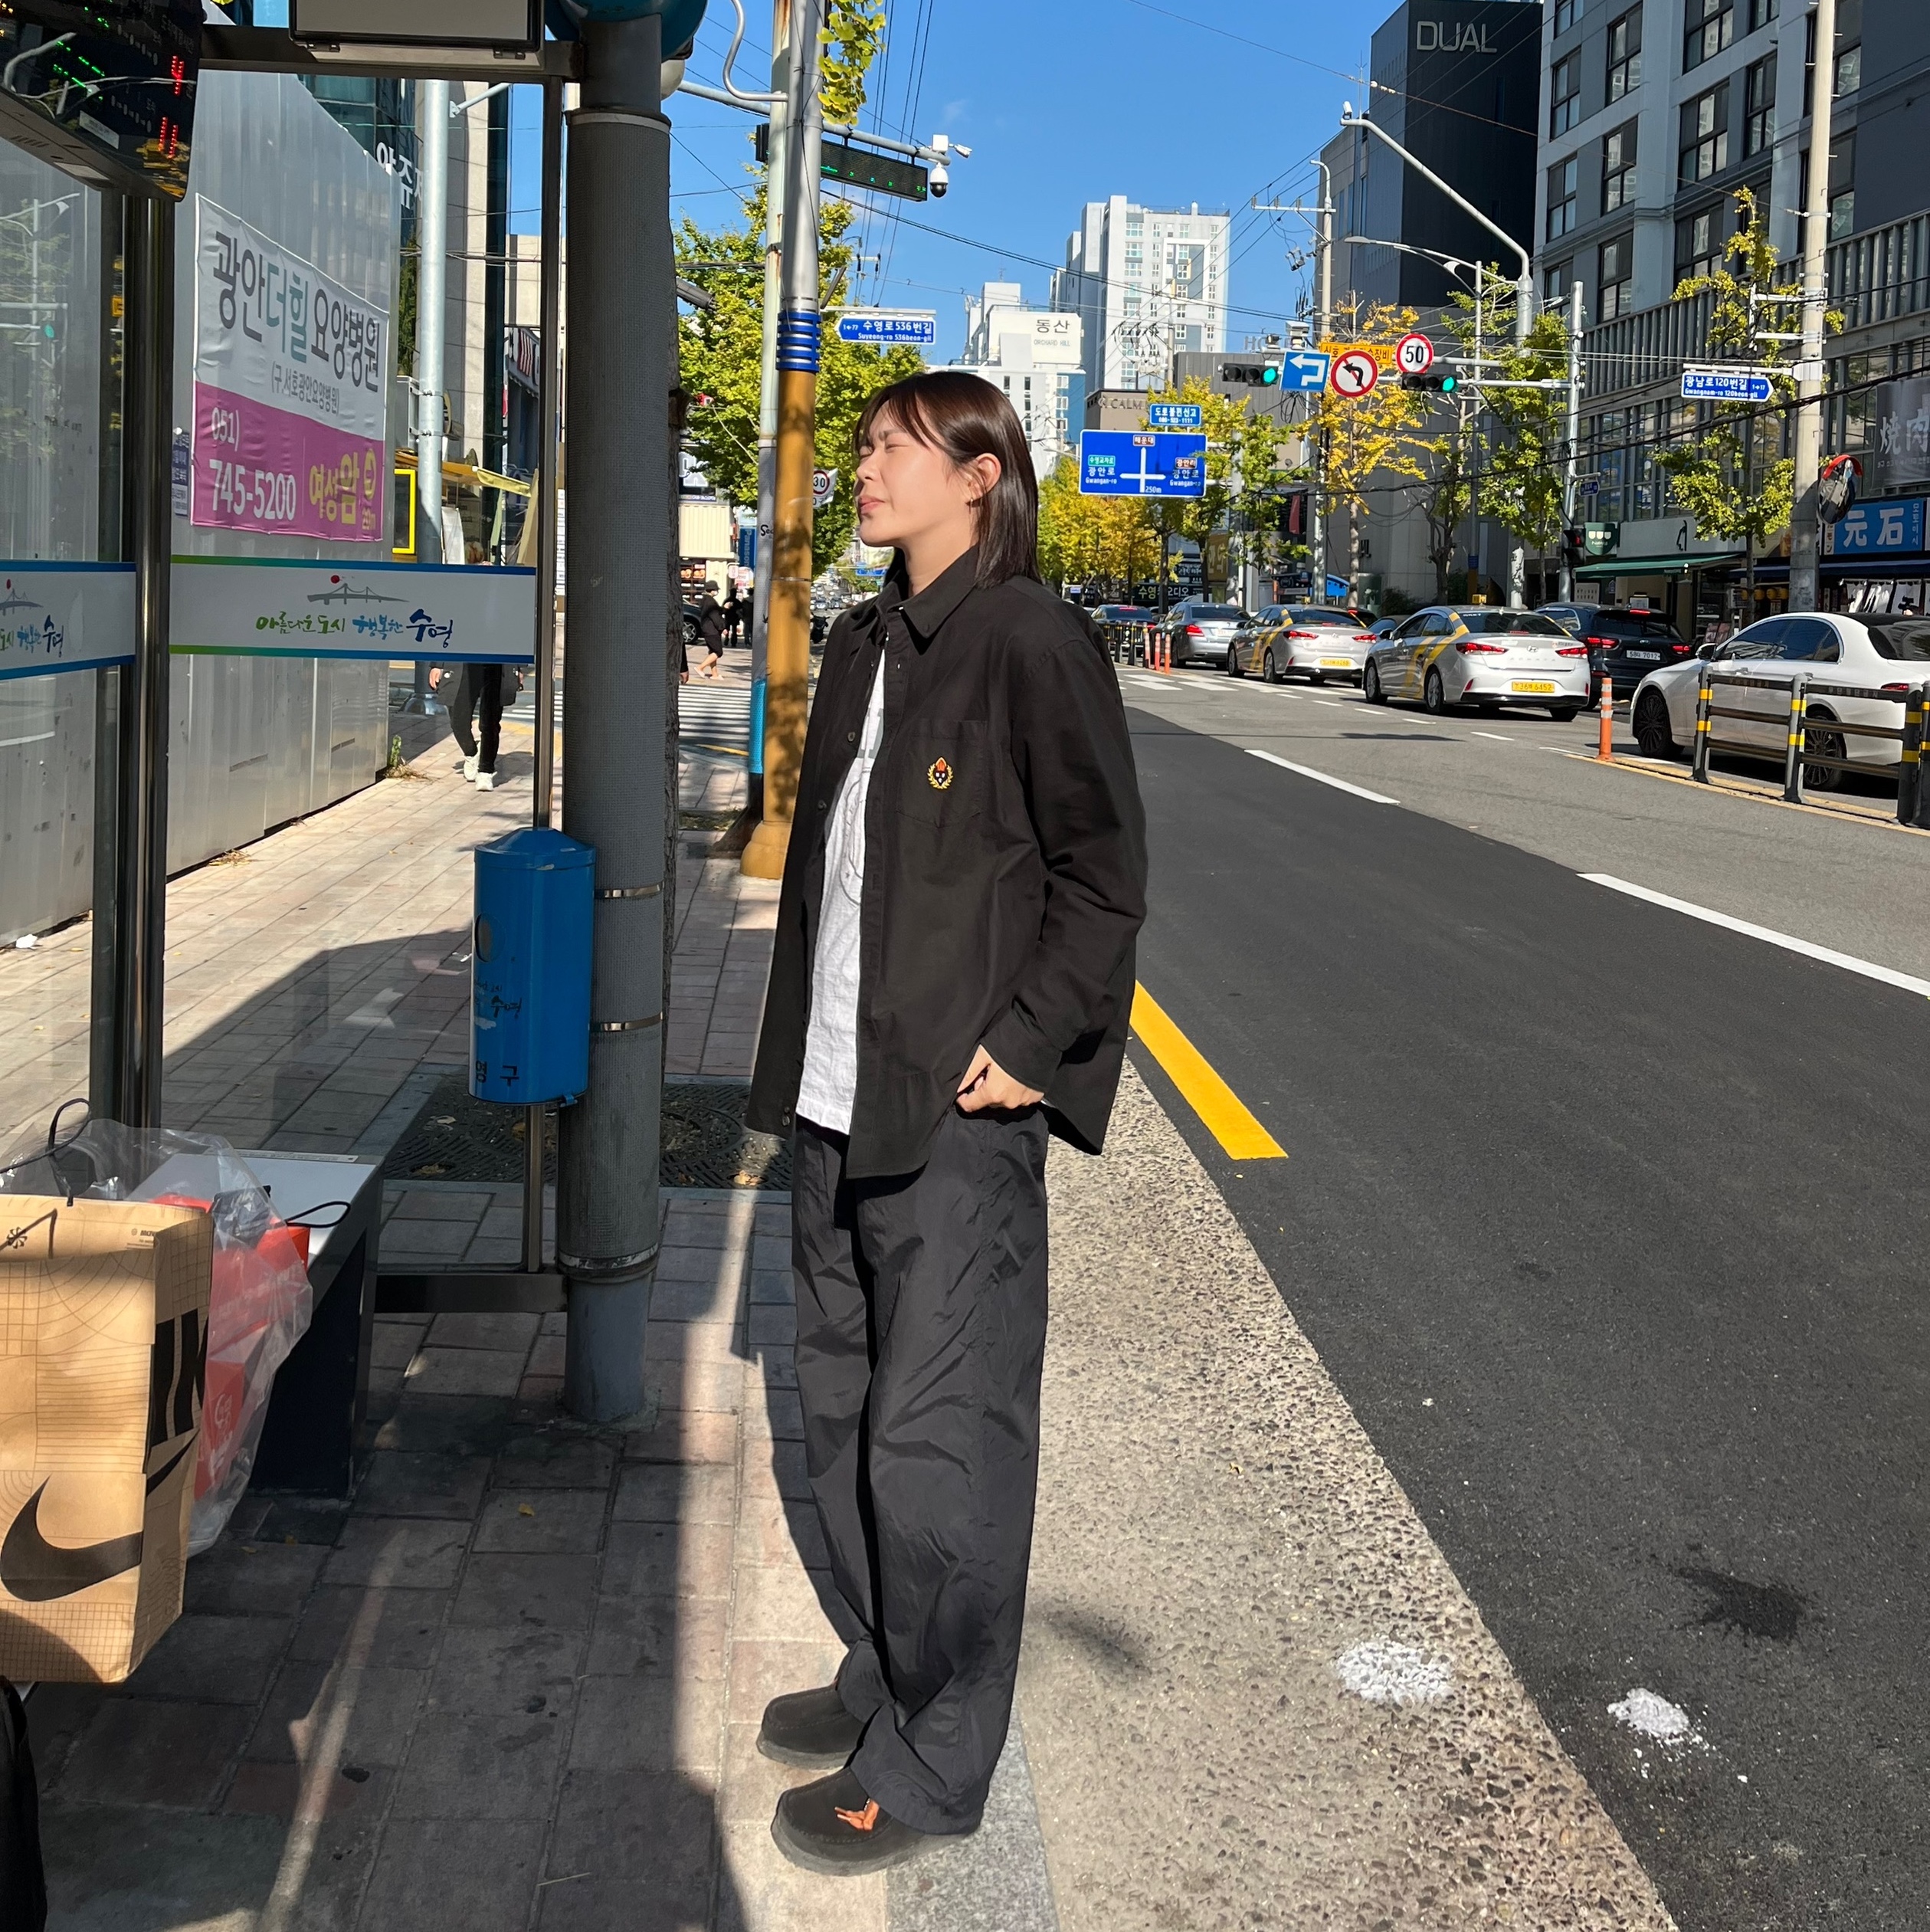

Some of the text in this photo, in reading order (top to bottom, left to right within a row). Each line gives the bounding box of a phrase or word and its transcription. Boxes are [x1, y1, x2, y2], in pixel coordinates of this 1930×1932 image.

[1417, 21, 1498, 53] DUAL
[171, 55, 184, 96] 4
[213, 230, 380, 393] 광안더힐 요양병원
[863, 320, 932, 334] 수영로536번길
[1036, 319, 1070, 333] 동산
[1405, 346, 1424, 364] 50
[1685, 376, 1747, 391] 광남로120번길
[211, 407, 239, 452] 051)
[813, 476, 826, 488] 30
[1087, 467, 1116, 477] 광안로
[1172, 469, 1200, 479] 광안로
[209, 459, 297, 520] 745-5200
[1843, 507, 1904, 548] 元石
[42, 614, 64, 658] 수영
[256, 608, 454, 649] 아름다운 도시 행복한 수영
